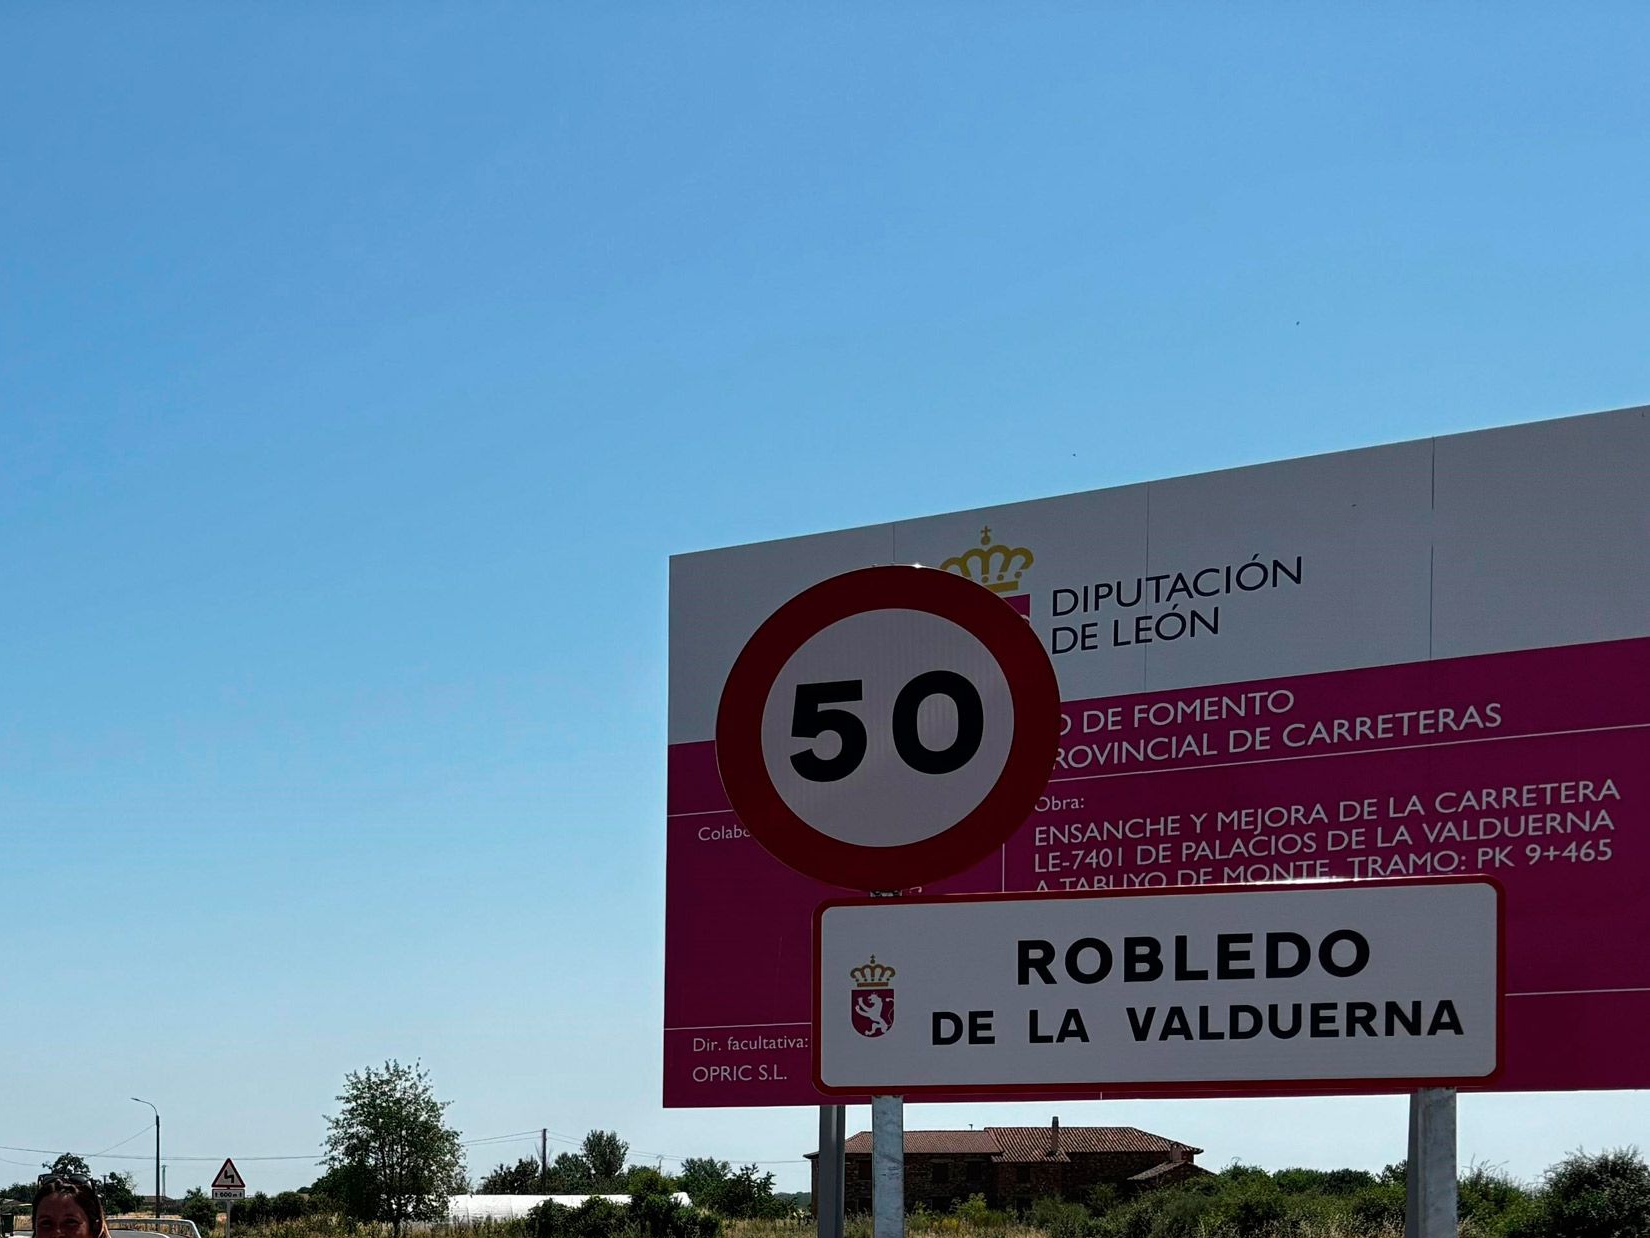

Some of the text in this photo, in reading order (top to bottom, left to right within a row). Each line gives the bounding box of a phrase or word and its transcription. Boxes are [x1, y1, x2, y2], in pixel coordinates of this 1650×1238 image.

[1052, 553, 1302, 617] DIPUTACIÓN
[1052, 604, 1219, 654] DE LEÓN
[790, 670, 984, 782] 50
[1083, 708, 1122, 733] DE
[1134, 689, 1294, 728] FOMENTO
[1229, 727, 1271, 753] DE
[1283, 703, 1501, 748] CARRETERAS
[1034, 796, 1085, 812] Obra:
[1035, 779, 1621, 846] ENSANCHE Y MEJORA DE LA CARRETERA
[1035, 810, 1615, 872] LE-7401 DE PALACIOS DE LA VALDUERNA
[1177, 868, 1212, 886] DE
[1347, 850, 1467, 880] TRAMO:
[1477, 846, 1515, 869] PK
[1525, 839, 1613, 865] 9+465
[1017, 929, 1370, 985] ROBLEDO
[693, 1035, 809, 1051] Dir. facultativa:
[932, 1000, 1464, 1046] DE LA VALDUERNA
[692, 1064, 787, 1082] OPRIC S.L.
